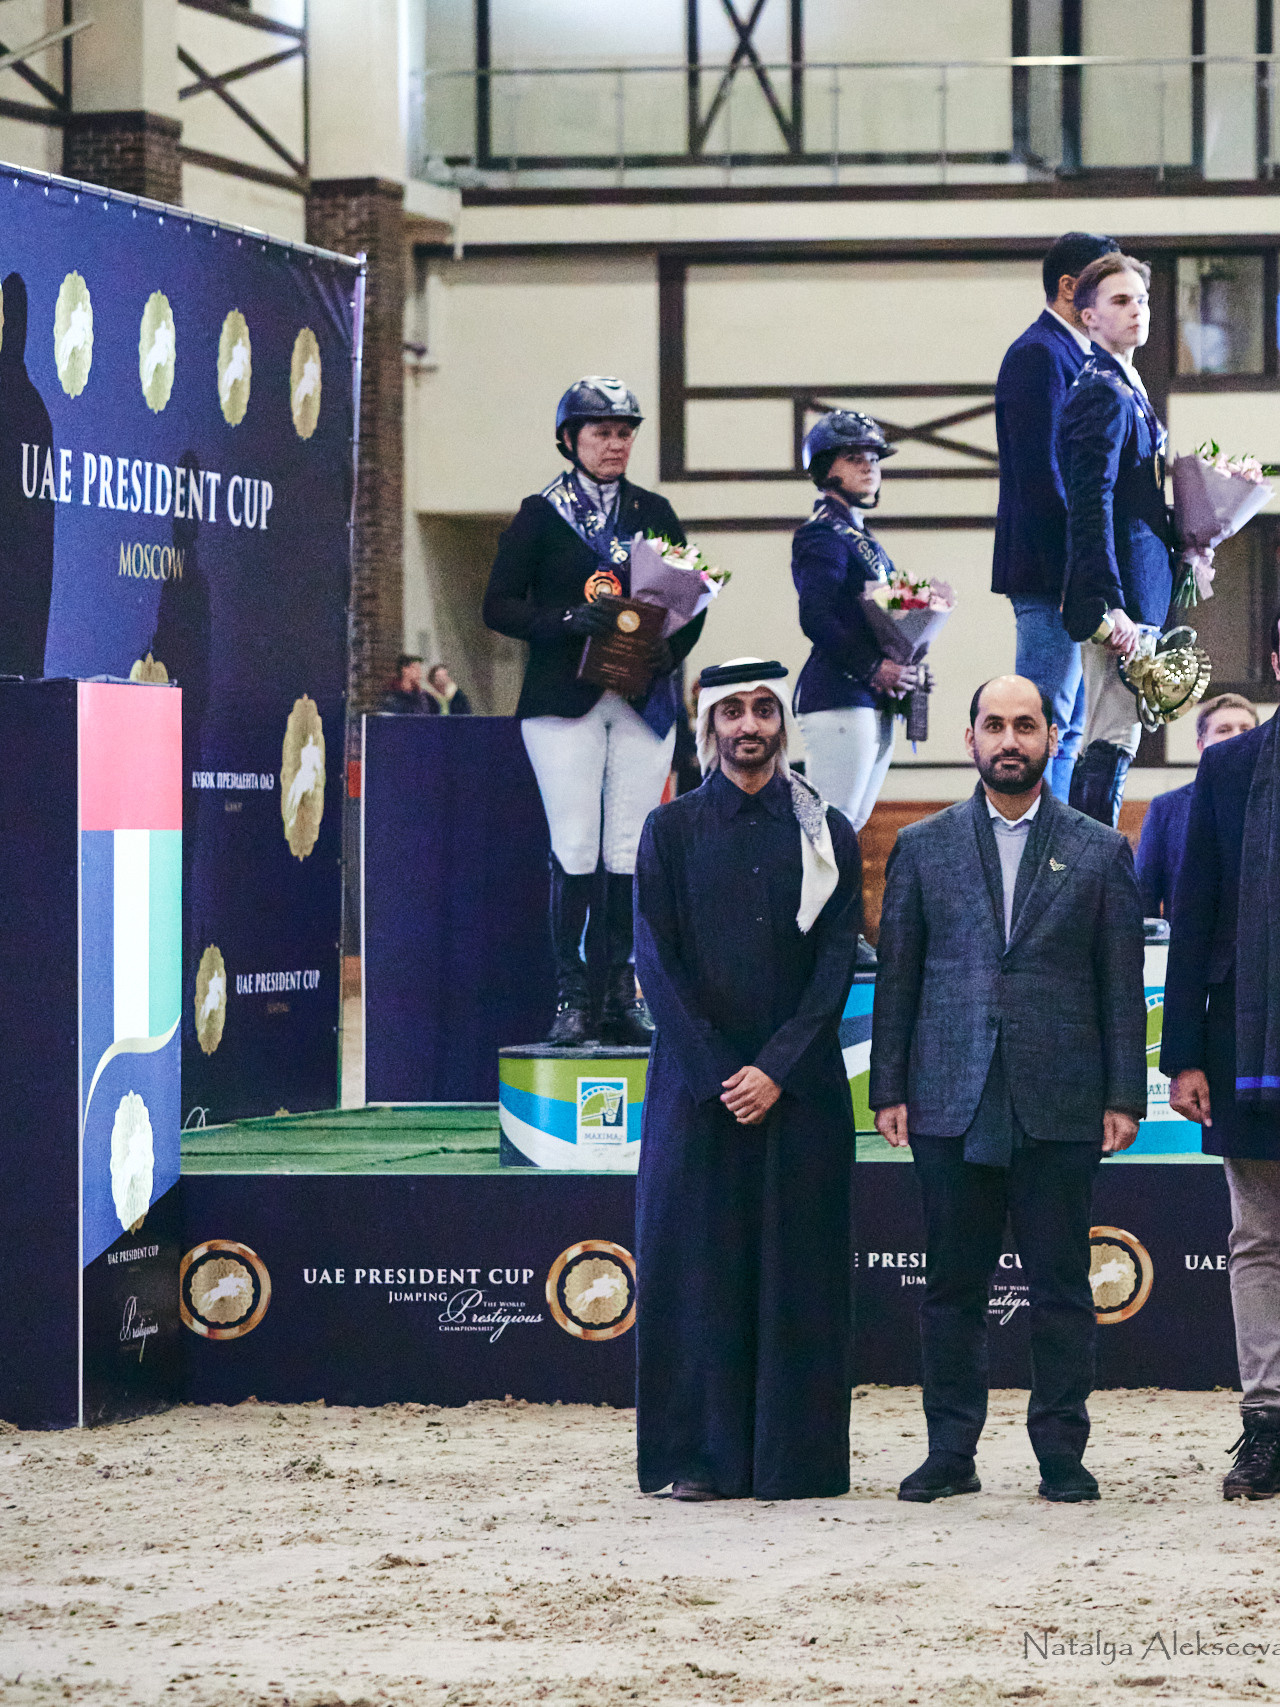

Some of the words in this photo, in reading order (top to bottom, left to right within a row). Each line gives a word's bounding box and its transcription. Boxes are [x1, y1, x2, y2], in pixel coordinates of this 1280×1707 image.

[21, 443, 72, 503] UAE
[82, 451, 221, 523] PRESIDENT
[227, 475, 274, 530] CUP
[118, 541, 185, 582] MOSCOW
[192, 771, 216, 789] КУБОК
[236, 974, 253, 995] UAE
[255, 970, 302, 993] PRESIDENT
[303, 969, 321, 990] CUP
[107, 1252, 119, 1265] UAE
[119, 1246, 148, 1263] PRESIDENT
[148, 1244, 159, 1257] CUP
[868, 1252, 927, 1268] PRESI
[1184, 1254, 1227, 1270] UAE
[303, 1268, 346, 1285] UAE
[354, 1268, 482, 1285] PRESIDENT
[488, 1268, 535, 1285] CUP
[438, 1288, 544, 1343] Prestigious
